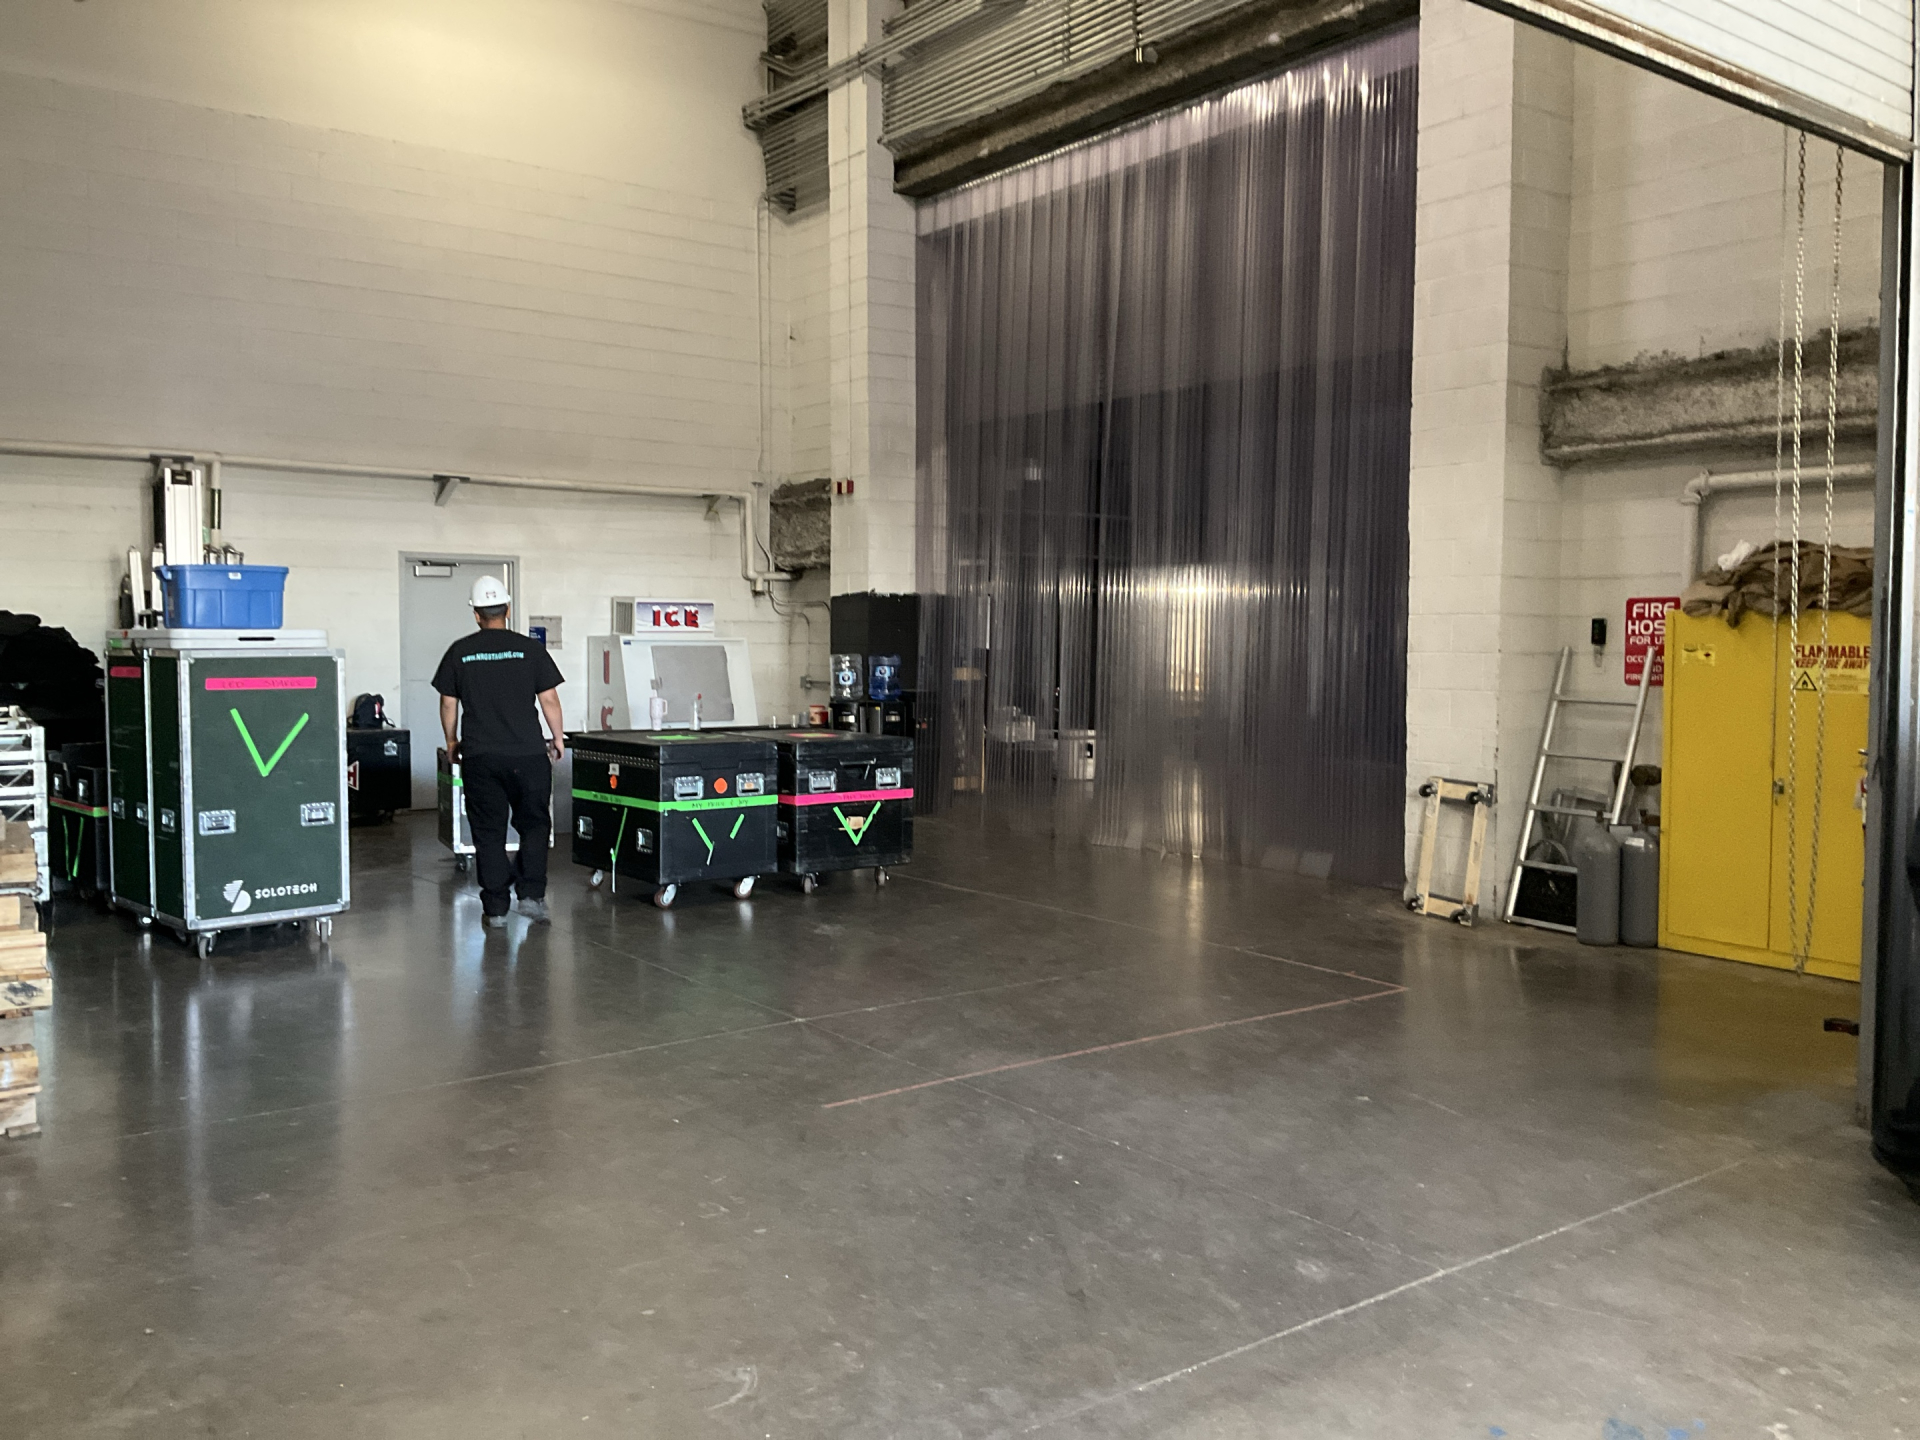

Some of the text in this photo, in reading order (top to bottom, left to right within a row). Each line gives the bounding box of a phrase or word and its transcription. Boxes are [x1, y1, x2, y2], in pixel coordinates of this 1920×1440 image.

[652, 605, 699, 628] ICE
[1627, 619, 1666, 635] HOS
[1629, 635, 1651, 645] FOR
[255, 882, 318, 899] SOLOTECH
